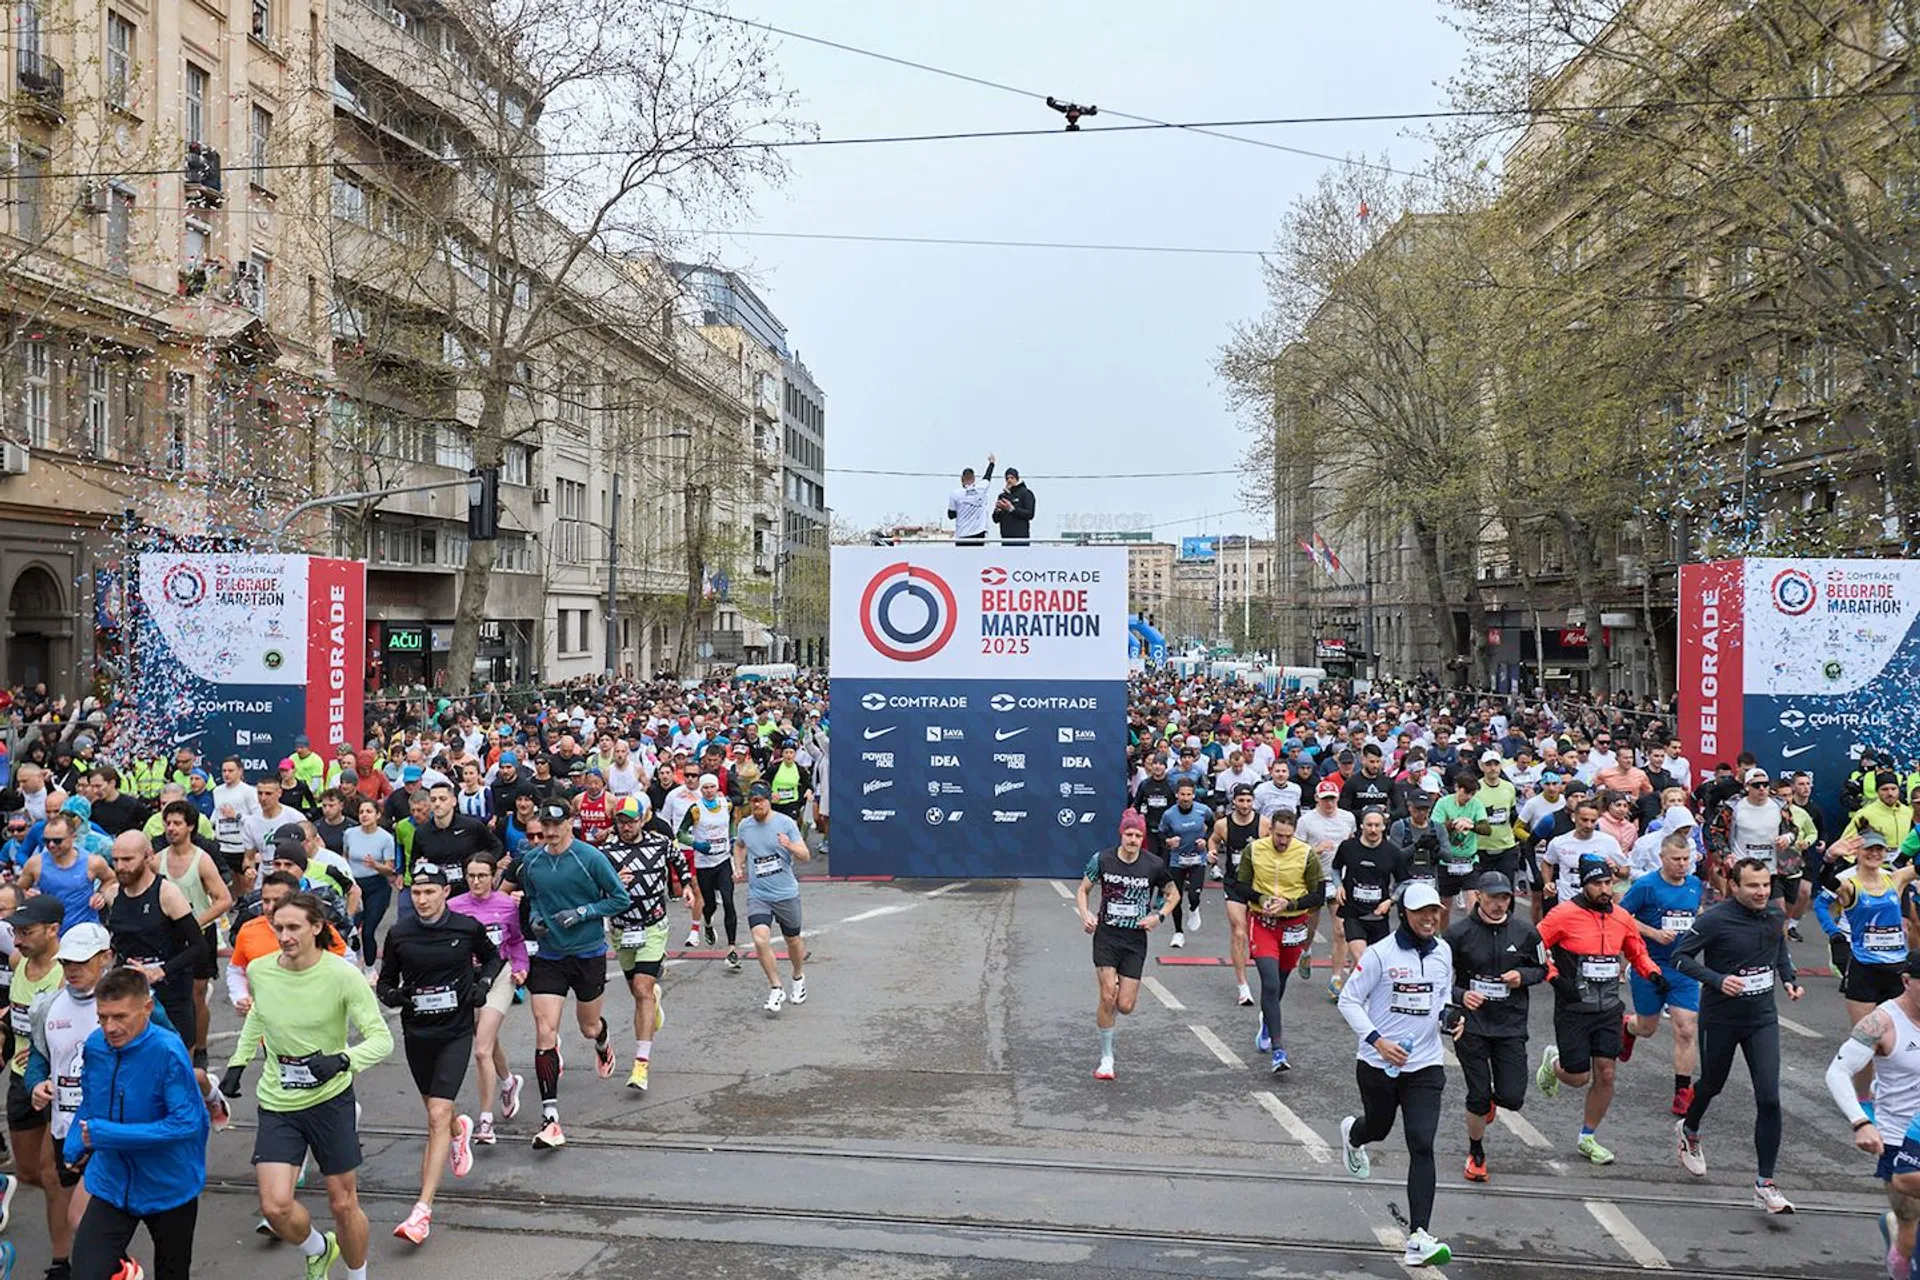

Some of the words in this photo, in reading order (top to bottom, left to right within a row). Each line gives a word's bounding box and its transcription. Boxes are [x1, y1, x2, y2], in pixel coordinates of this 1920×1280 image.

[1012, 570, 1100, 583] COMTRADE
[1847, 572, 1901, 580] COMTRADE
[1827, 584, 1894, 599] BELGRADE
[982, 590, 1088, 612] BELGRADE
[1827, 600, 1901, 614] MARATHON
[982, 614, 1100, 637] MARATHON
[982, 638, 1030, 654] 2025
[330, 585, 346, 745] BELGRADE
[1702, 590, 1720, 756] BELGRADE
[198, 701, 273, 713] COMTRADE
[890, 696, 968, 709] COMTRADE
[1018, 697, 1098, 710] COMTRADE
[1808, 713, 1892, 727] COMTRADE
[943, 729, 964, 737] SAVA
[1075, 730, 1097, 738] SAVA
[930, 755, 961, 767] IDEA
[1062, 757, 1092, 768] IDEA
